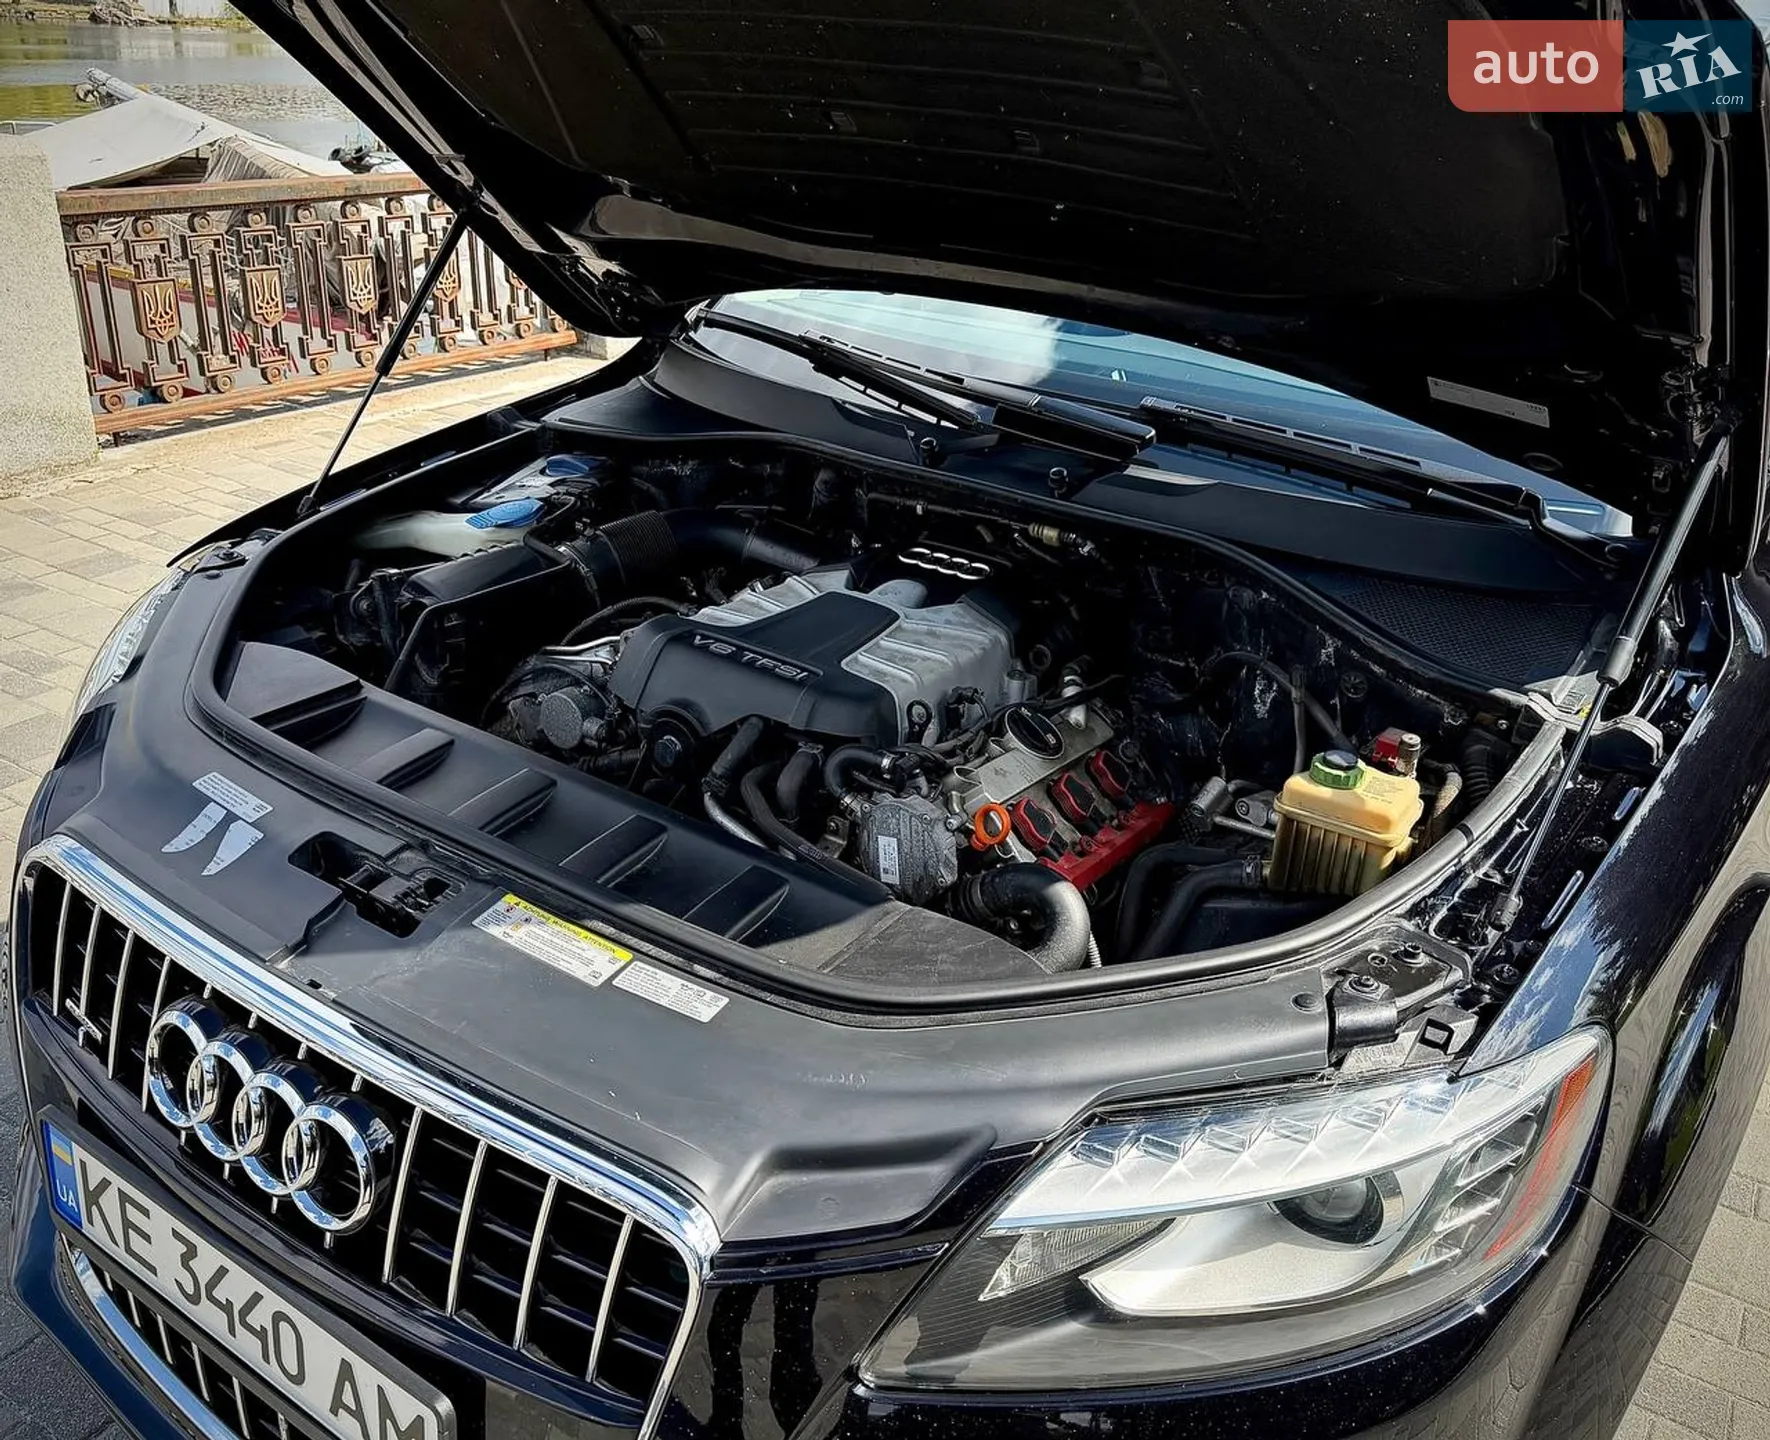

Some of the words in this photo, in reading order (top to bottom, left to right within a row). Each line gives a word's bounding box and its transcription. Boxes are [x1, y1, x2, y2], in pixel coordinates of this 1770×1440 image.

[694, 635, 736, 655] V6
[741, 651, 809, 681] TFSI
[56, 1179, 79, 1213] UA
[79, 1158, 158, 1278] KE
[171, 1227, 306, 1386] 3440
[329, 1357, 424, 1440] AM
